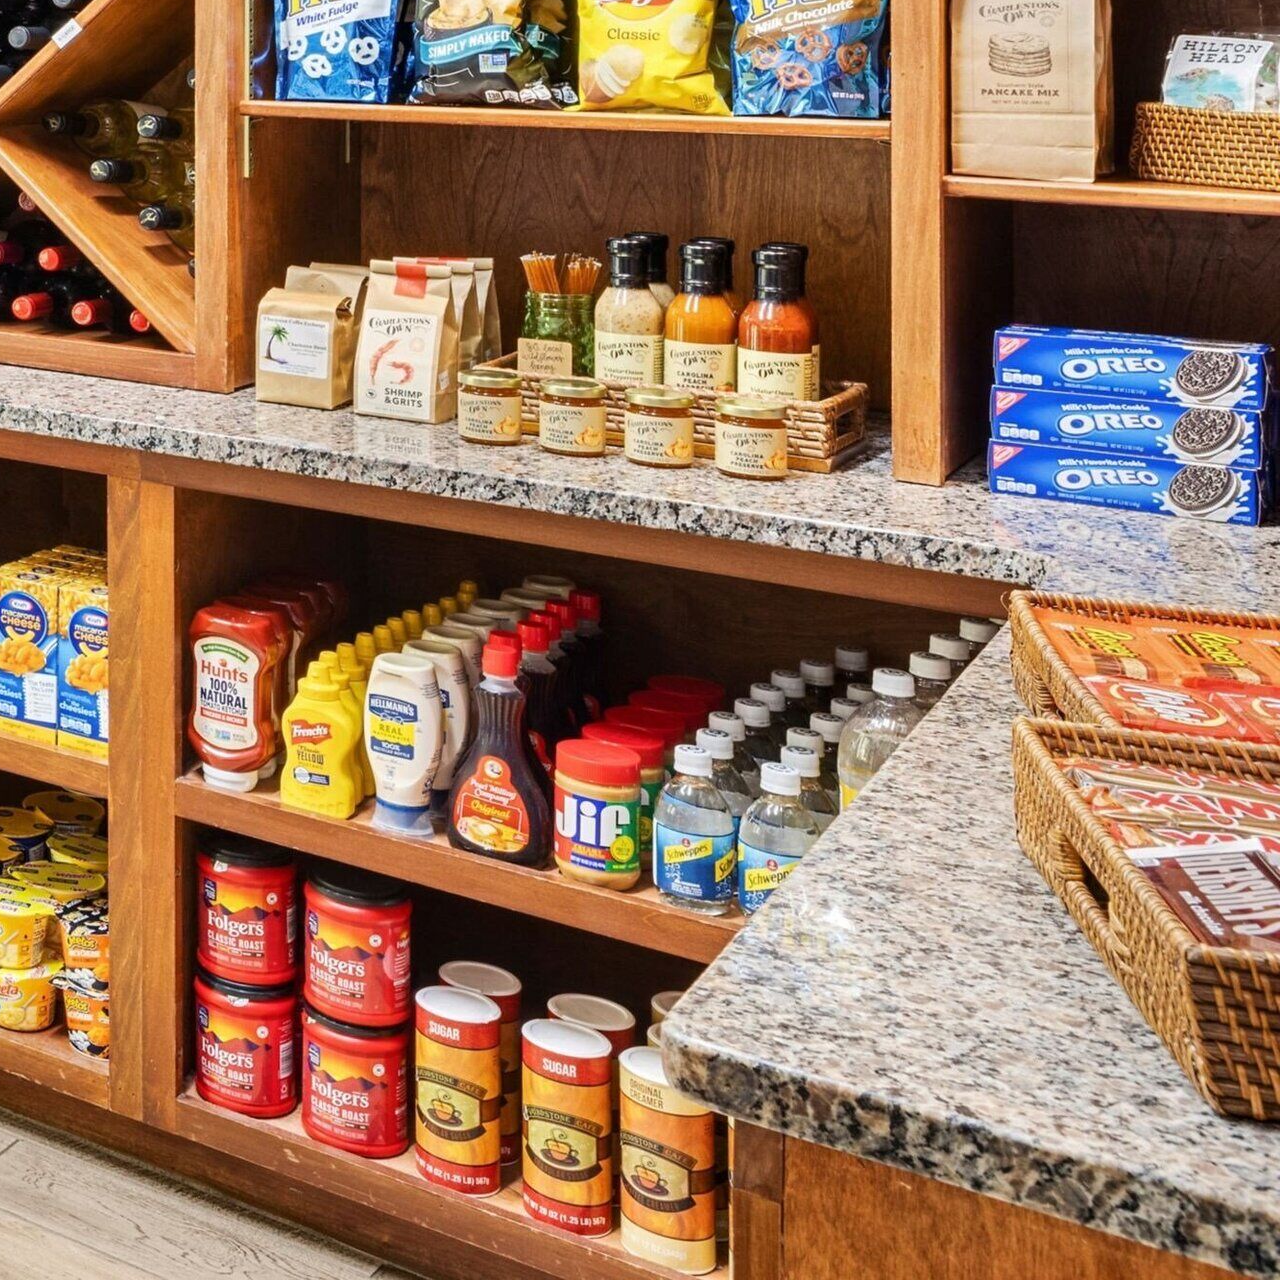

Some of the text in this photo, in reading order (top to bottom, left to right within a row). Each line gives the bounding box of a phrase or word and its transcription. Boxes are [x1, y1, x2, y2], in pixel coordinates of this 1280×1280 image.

[296, 0, 359, 27] White Fudge
[753, 0, 855, 35] Milk Chocolate
[427, 30, 511, 59] SIMPLY NAKED
[607, 28, 661, 41] Classic
[1182, 39, 1263, 53] HILTON
[1189, 52, 1246, 64] HEAD
[981, 88, 1060, 97] PANCAKE MIX
[1089, 347, 1154, 356] Favorite Cookie
[1060, 357, 1167, 381] OREO
[384, 387, 423, 397] SHRIMP
[1087, 403, 1150, 412] Favorite Cookie
[1057, 413, 1163, 436] OREO
[638, 444, 659, 452] PEACH
[1084, 459, 1147, 468] Favorite Cookie
[1053, 469, 1160, 491] OREO
[210, 678, 238, 696] 100%
[200, 687, 248, 710] NATURAL
[370, 697, 415, 717] HELLMANN'S
[59, 701, 97, 718] cheesiest
[291, 723, 329, 738] French's
[379, 723, 402, 736] REAL
[296, 751, 325, 765] YELLOW
[473, 788, 509, 806] Company
[470, 799, 511, 820] Original
[555, 795, 631, 848] Jif
[666, 842, 710, 862] Schweppes
[208, 910, 264, 937] Folgers
[208, 930, 265, 951] CLASSIC ROAST
[310, 943, 365, 977] Folgers
[310, 964, 365, 991] CLASSIC ROAST
[429, 1021, 460, 1041] SUGAR
[202, 1037, 254, 1068] Folgers
[201, 1056, 254, 1083] CLASSIC ROAST
[542, 1058, 577, 1079] SUGAR
[311, 1075, 369, 1108] Folgers
[629, 1078, 664, 1098] ORIGINAL
[311, 1097, 369, 1122] CLASSIC ROAST
[629, 1089, 664, 1110] CREAMER
